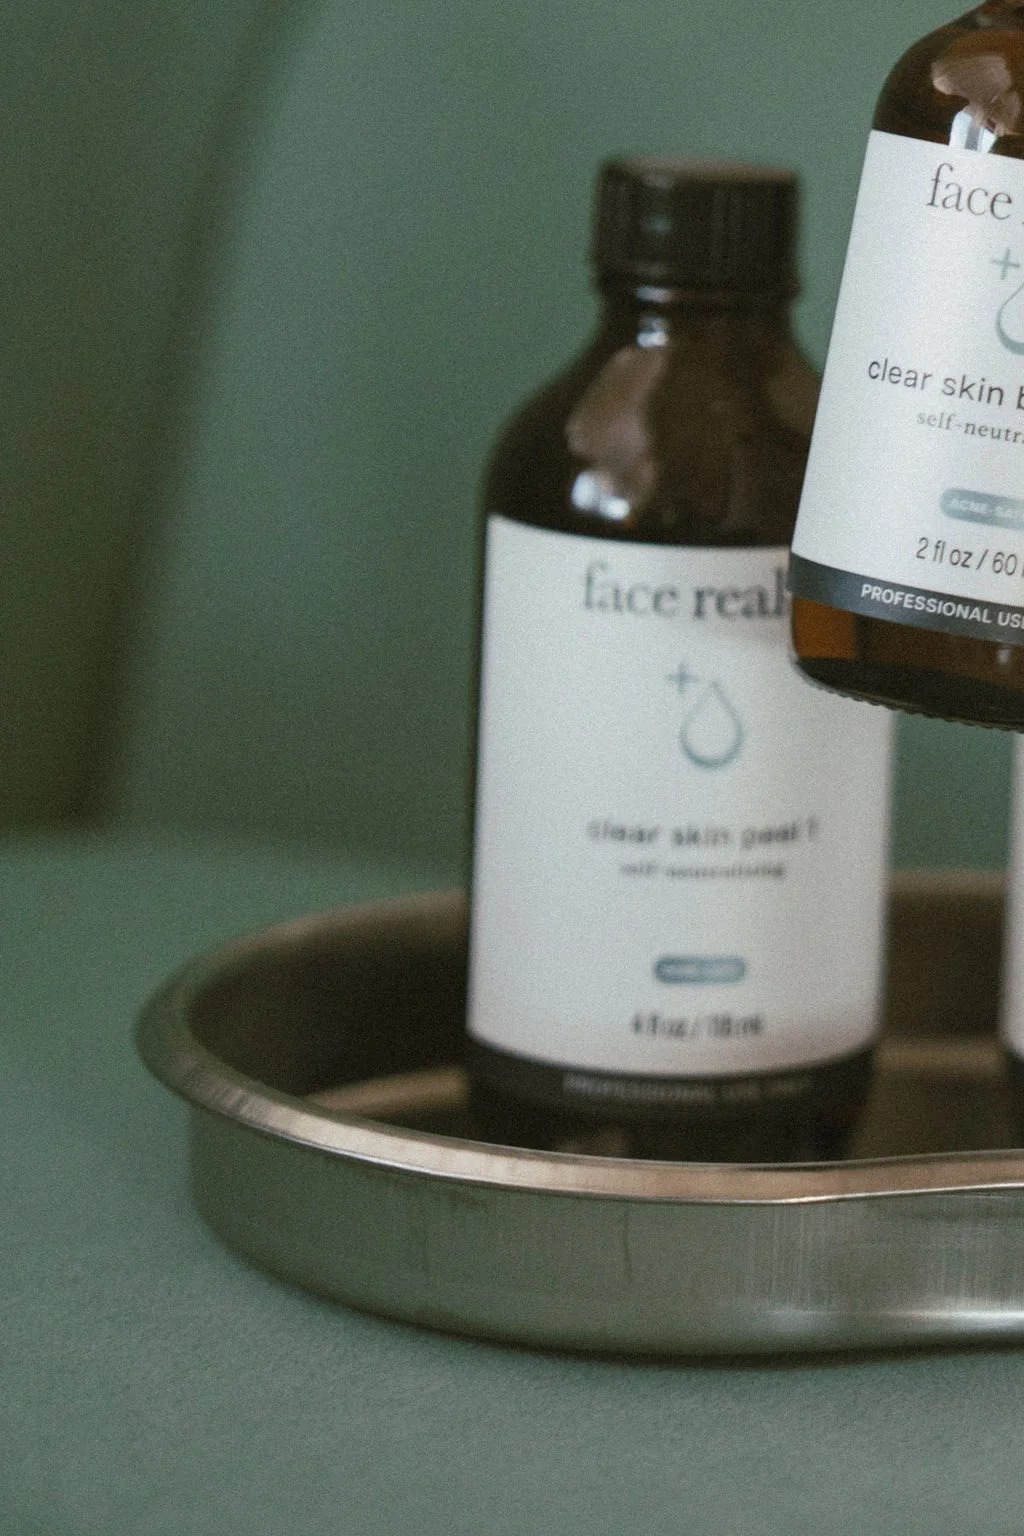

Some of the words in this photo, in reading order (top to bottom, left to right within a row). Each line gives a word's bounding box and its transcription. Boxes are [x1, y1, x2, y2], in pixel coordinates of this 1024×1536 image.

[926, 162, 1013, 221] face
[868, 358, 933, 391] clear
[941, 374, 1005, 406] skin
[916, 537, 929, 560] 2
[932, 540, 947, 564] fl
[949, 548, 974, 569] oz
[975, 548, 989, 571] /
[991, 551, 1018, 576] 60
[582, 560, 679, 616] face
[693, 567, 787, 619] real
[860, 582, 992, 624] PROFESSIONAL
